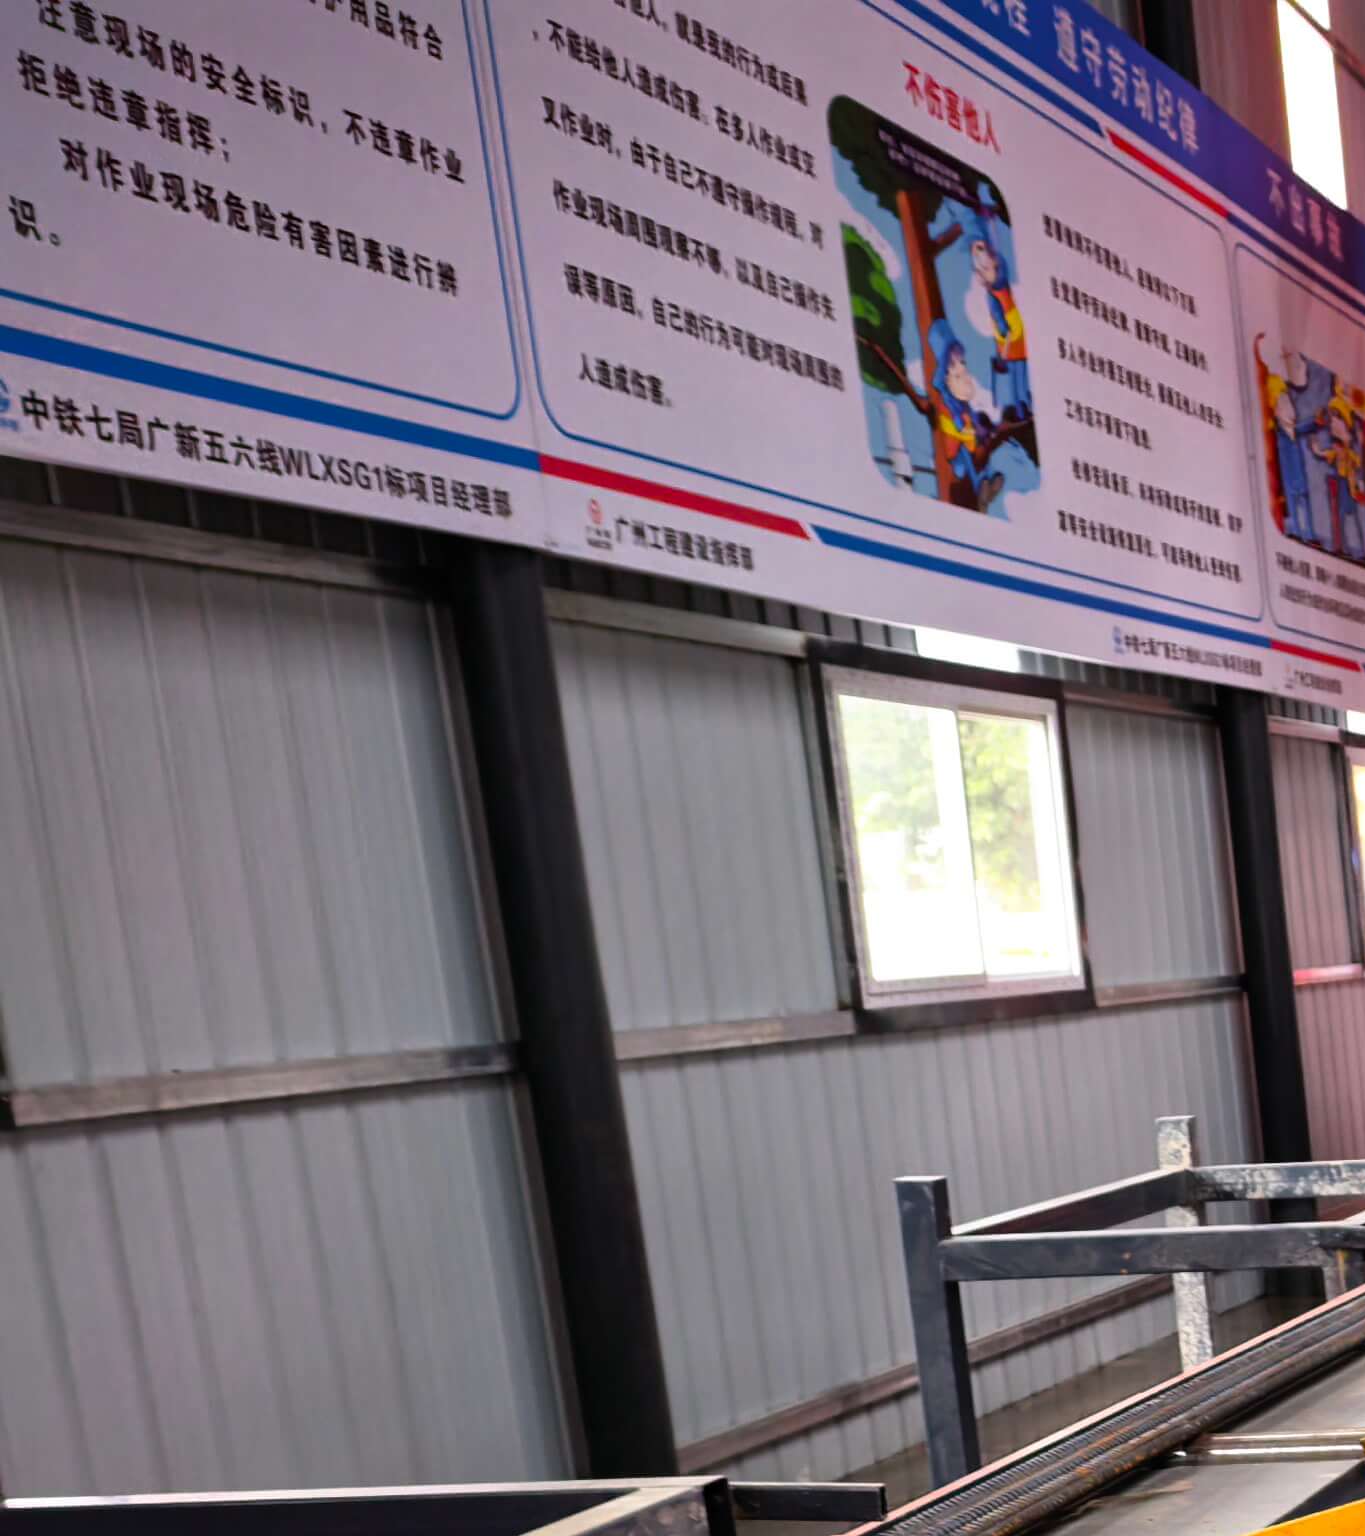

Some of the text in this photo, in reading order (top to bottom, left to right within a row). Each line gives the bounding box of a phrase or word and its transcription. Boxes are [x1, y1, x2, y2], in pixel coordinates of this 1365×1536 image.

[902, 60, 1002, 154] 不伤害他人
